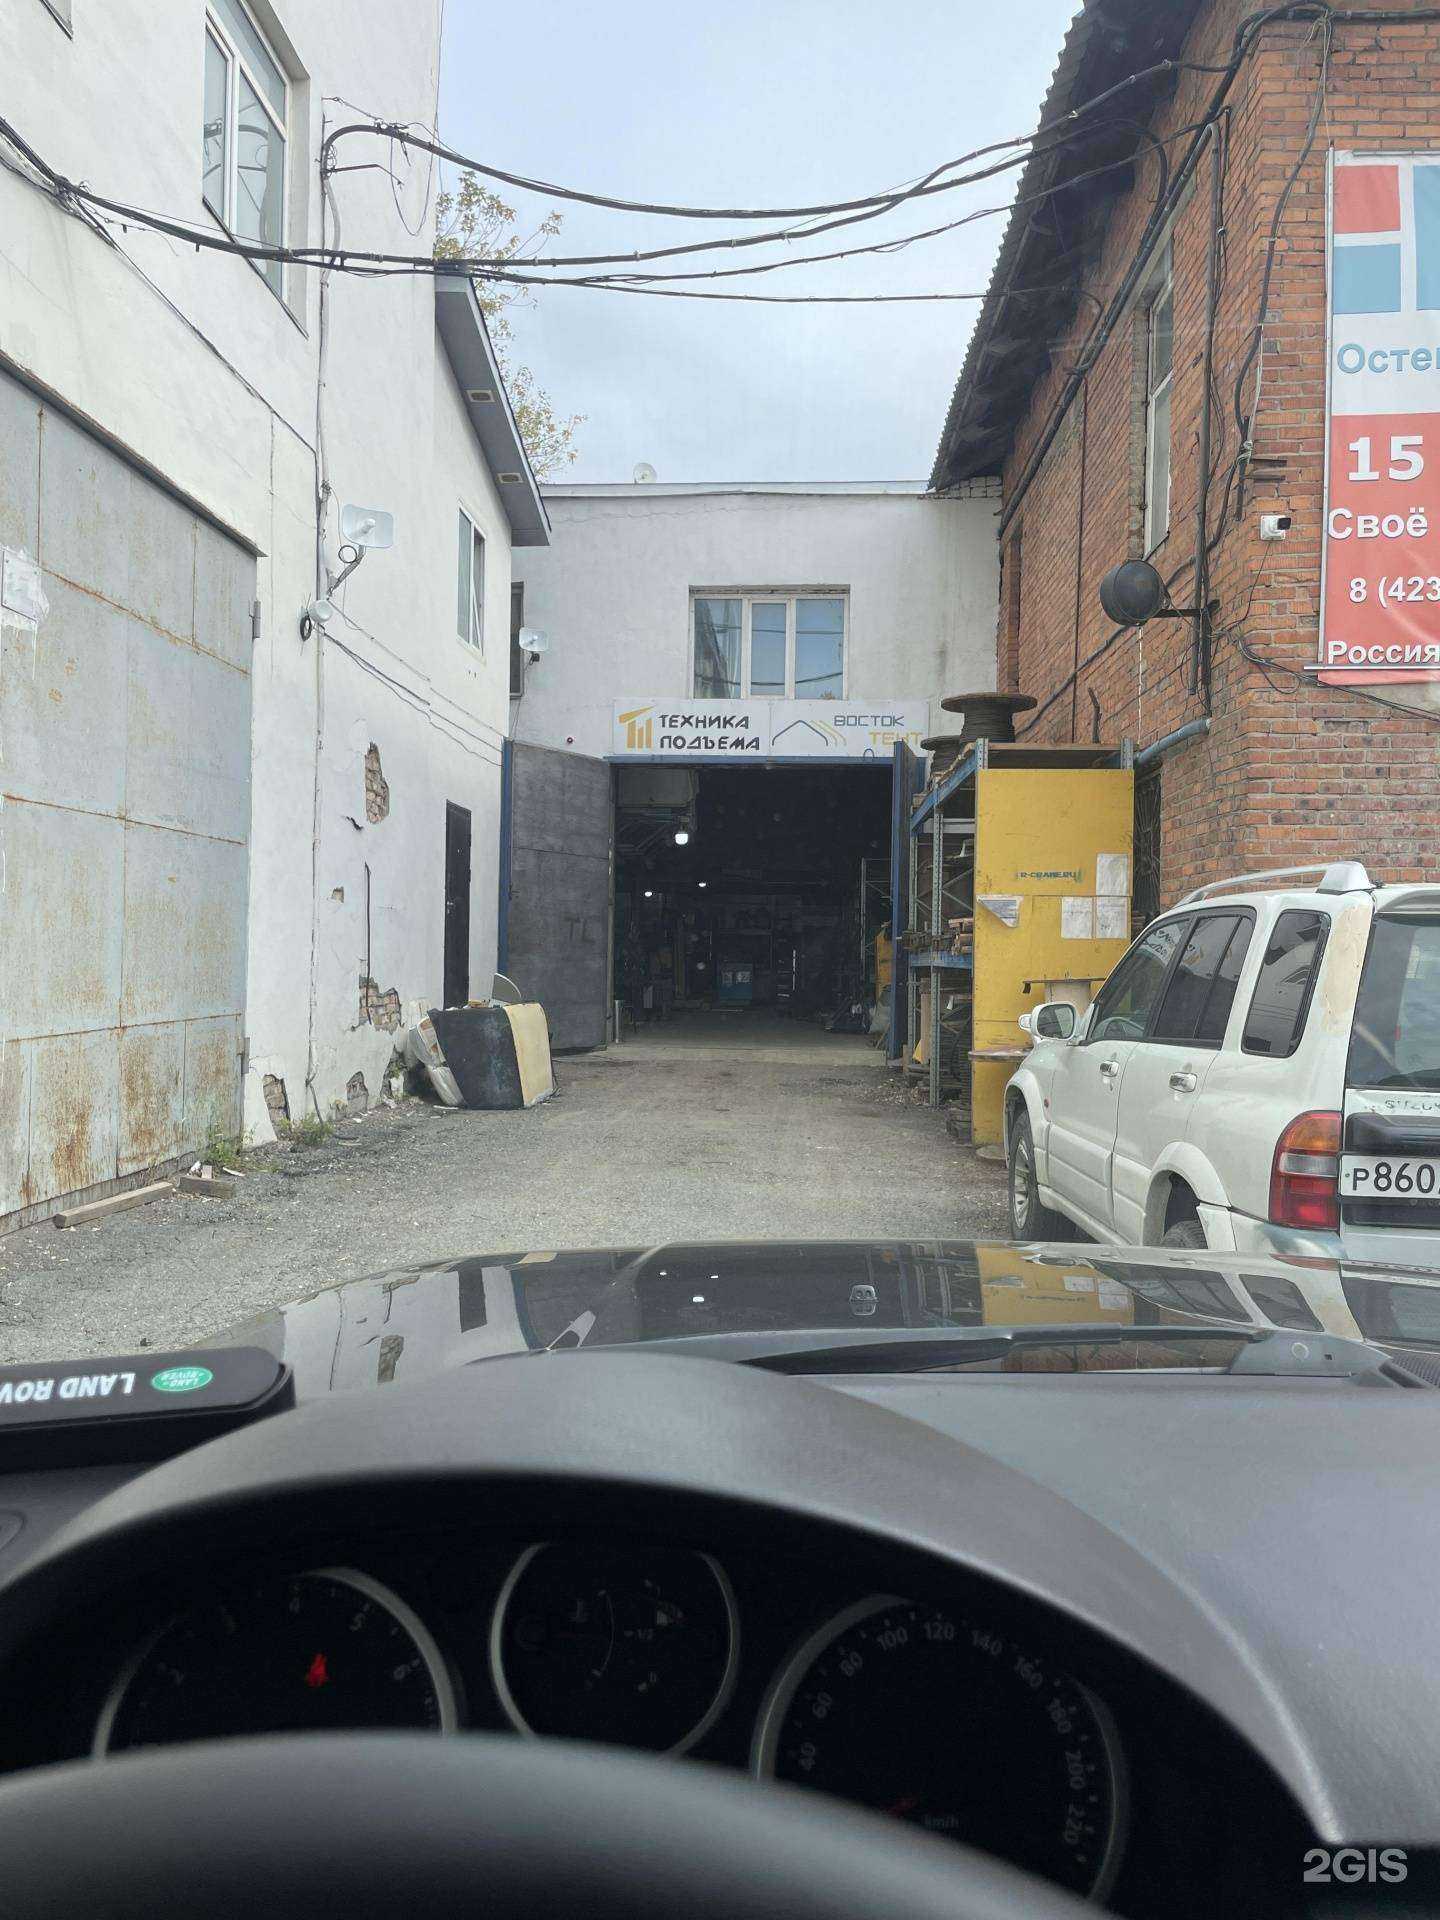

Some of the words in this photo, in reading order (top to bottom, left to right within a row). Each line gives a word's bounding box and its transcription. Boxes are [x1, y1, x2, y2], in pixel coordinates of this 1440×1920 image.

[1337, 343, 1440, 374] Осте
[1347, 435, 1425, 481] 15
[1328, 507, 1428, 540] Своё
[1348, 577, 1367, 602] 8
[1378, 575, 1440, 608] (423
[1327, 640, 1440, 665] Россия
[659, 714, 749, 729] ТЕХНИКА
[834, 714, 905, 727] ВОСТОК
[660, 735, 760, 751] ПОДЪЕМА
[1352, 1161, 1440, 1194] Р860
[59, 1371, 136, 1399] LAND
[876, 1626, 908, 1652] 100
[923, 1621, 955, 1641] 120
[971, 1629, 1003, 1656] 140
[839, 1650, 864, 1679] 80
